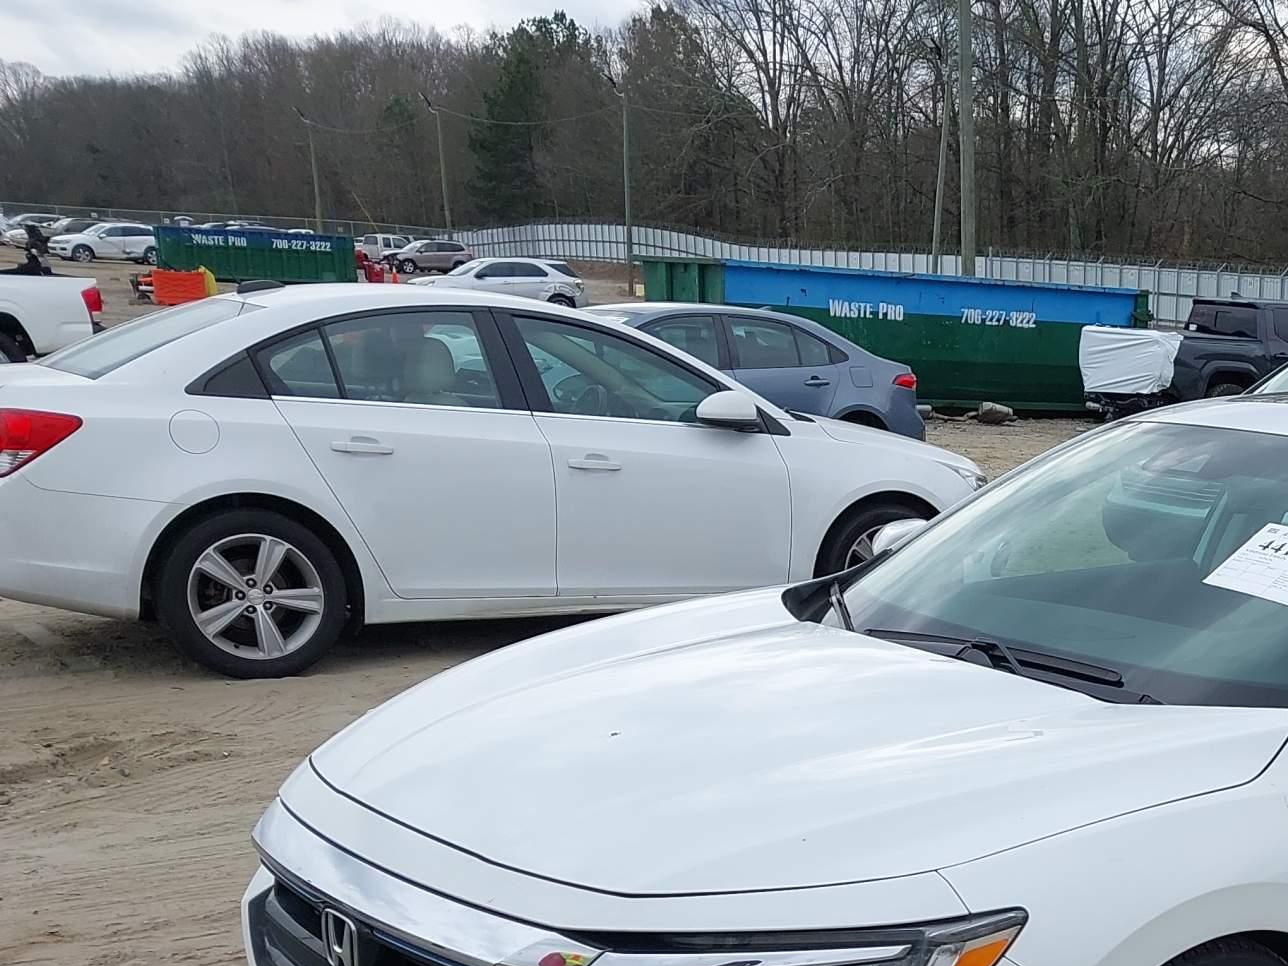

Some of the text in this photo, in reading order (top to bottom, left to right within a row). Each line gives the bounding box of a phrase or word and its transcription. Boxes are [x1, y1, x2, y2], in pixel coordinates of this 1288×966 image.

[191, 234, 247, 247] WASTE PRO
[829, 299, 904, 321] WASTE PRO
[961, 308, 1037, 328] 706-227-3222
